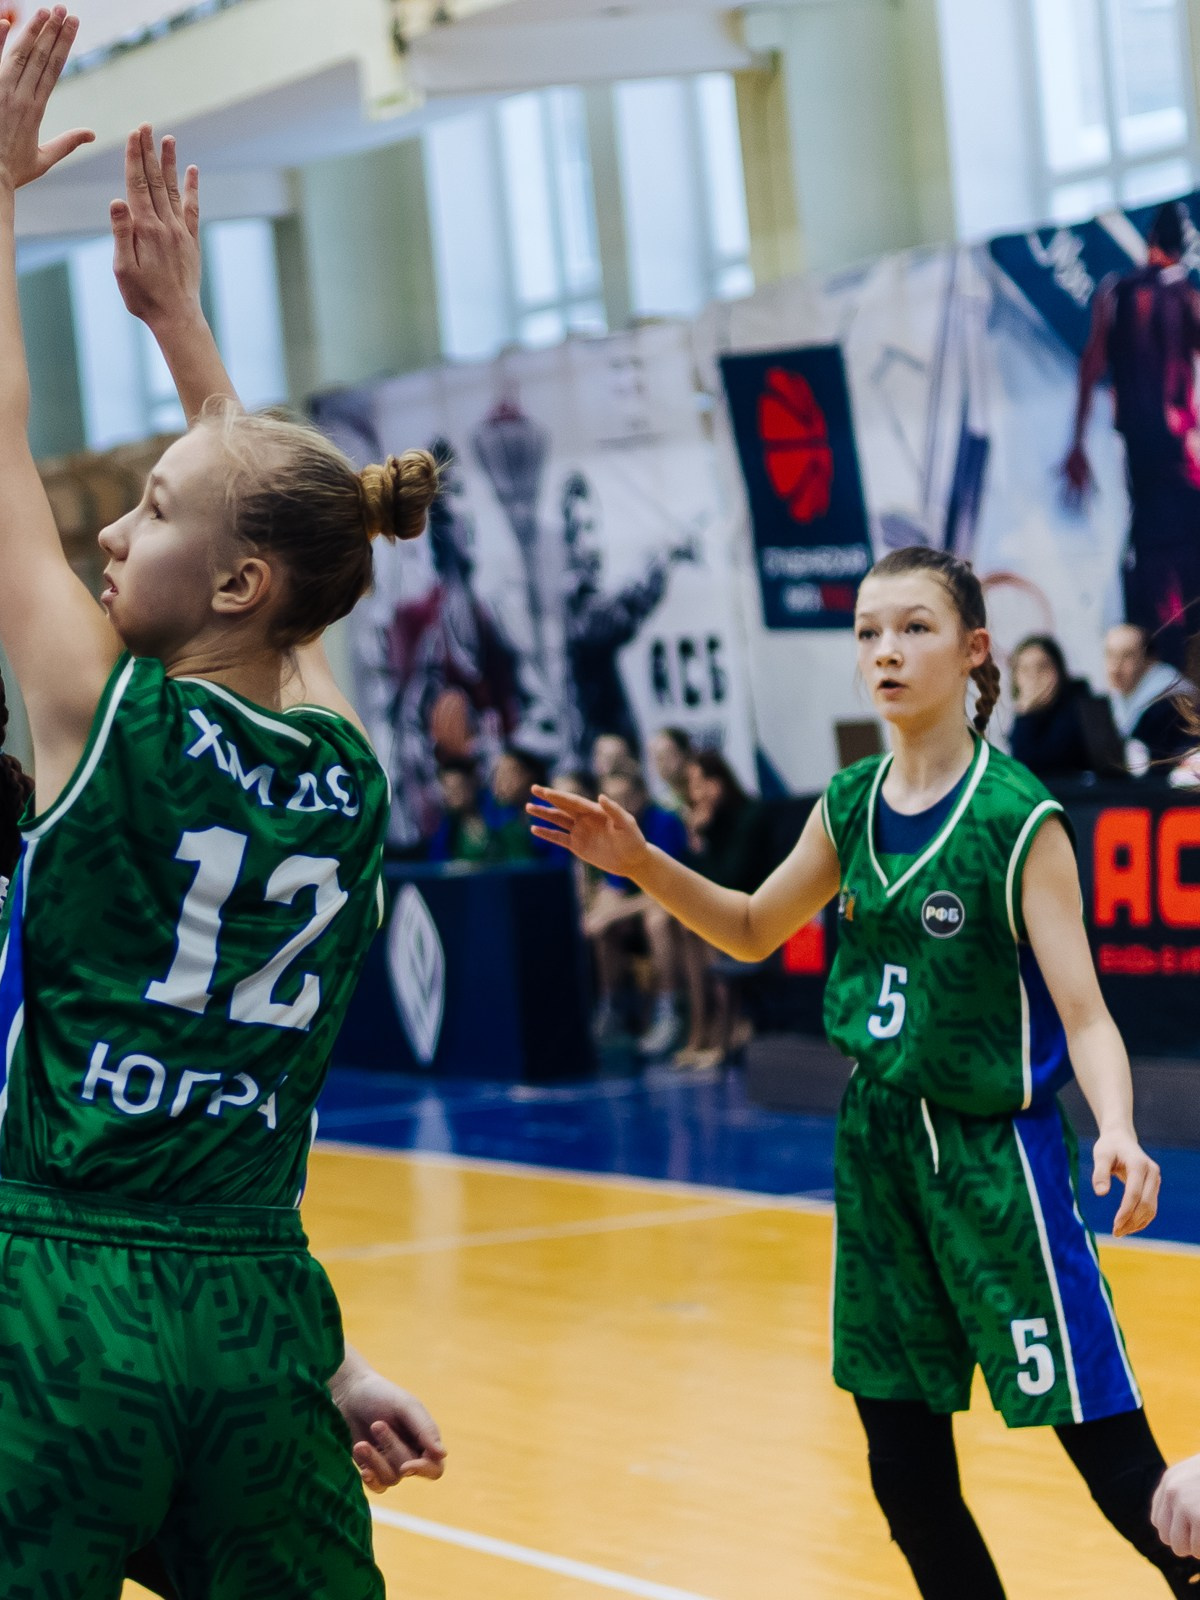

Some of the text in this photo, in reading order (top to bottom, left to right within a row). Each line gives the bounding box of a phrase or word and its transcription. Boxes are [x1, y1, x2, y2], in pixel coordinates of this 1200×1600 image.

[144, 825, 349, 1032] 12
[925, 905, 960, 924] РФБ
[867, 963, 908, 1040] 5
[1010, 1317, 1056, 1396] 5
